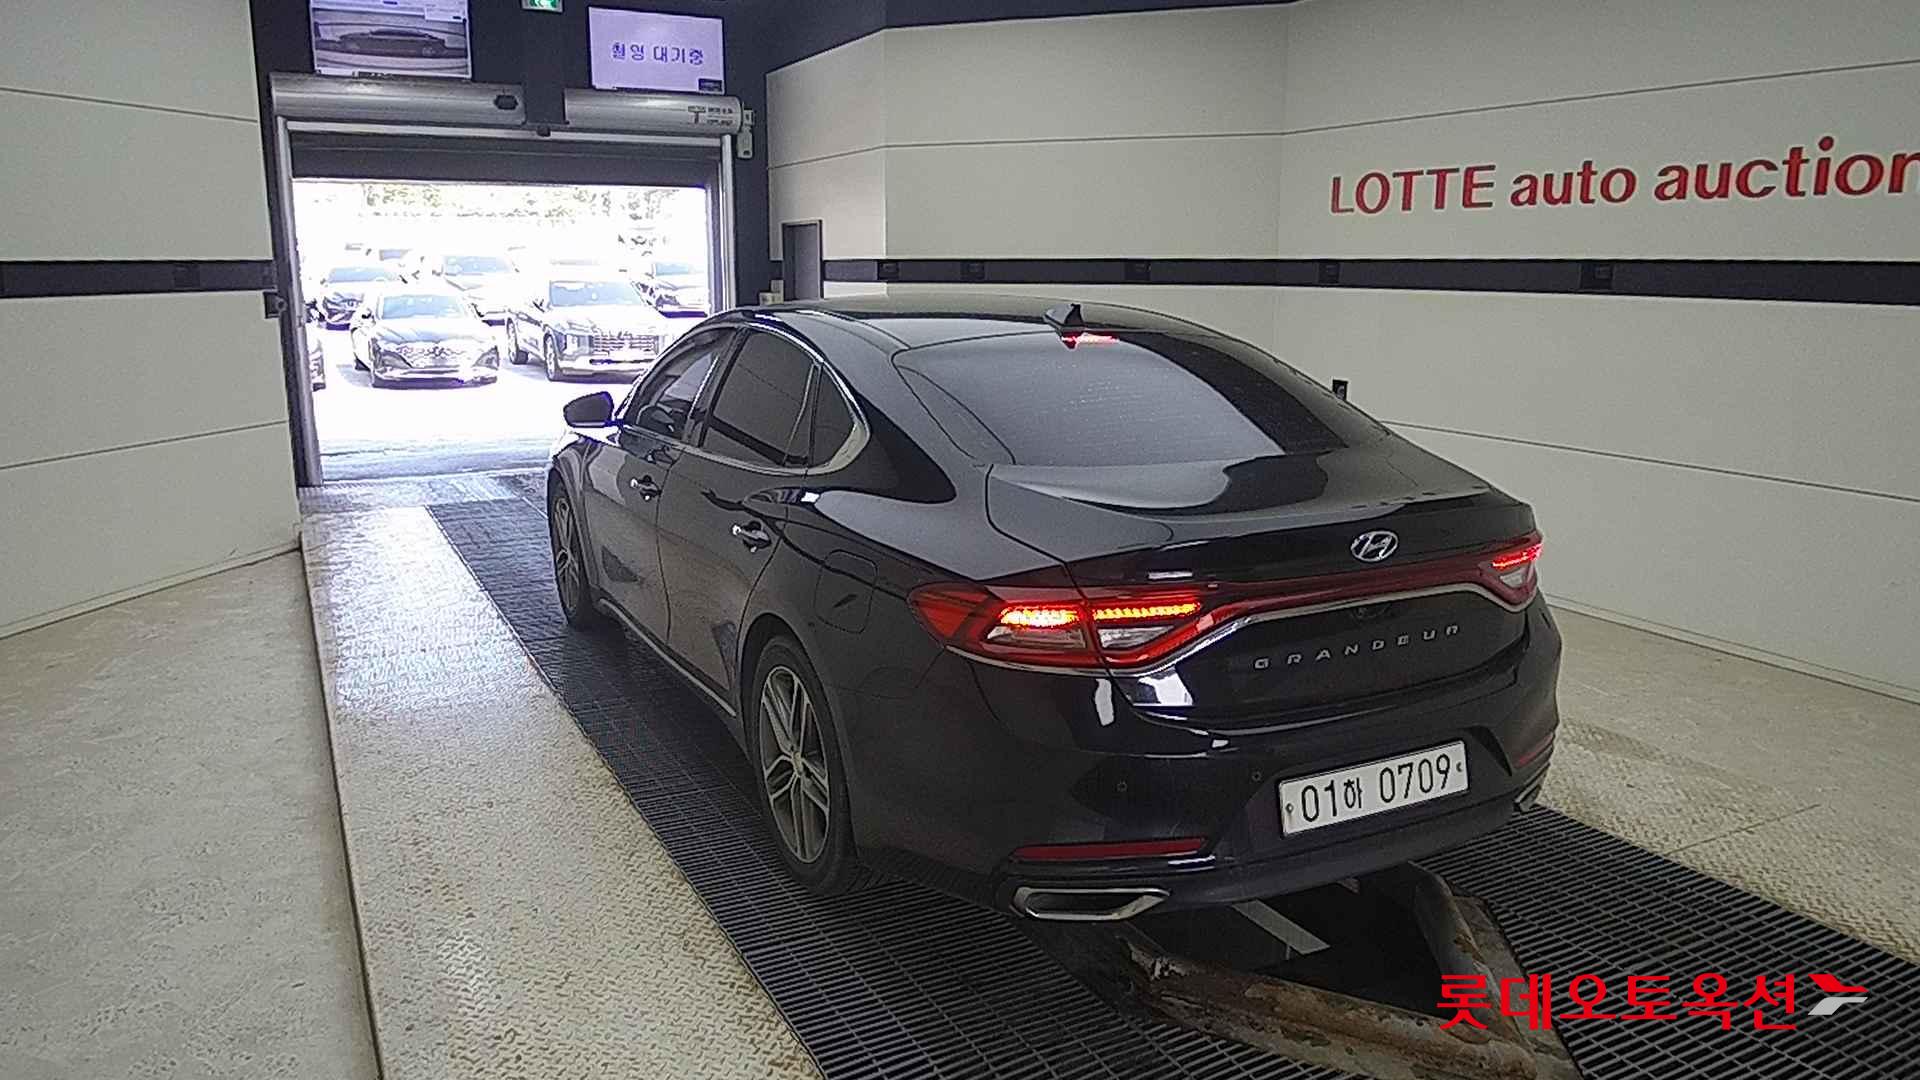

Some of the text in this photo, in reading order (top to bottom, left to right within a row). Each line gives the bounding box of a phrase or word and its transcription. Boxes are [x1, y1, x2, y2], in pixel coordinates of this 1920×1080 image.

[653, 46, 704, 66] 대기중
[1331, 164, 1496, 214] LOTTE
[1510, 160, 1637, 208] auto
[1254, 625, 1459, 669] GRANDEUR
[1300, 753, 1451, 823] 01하 0709
